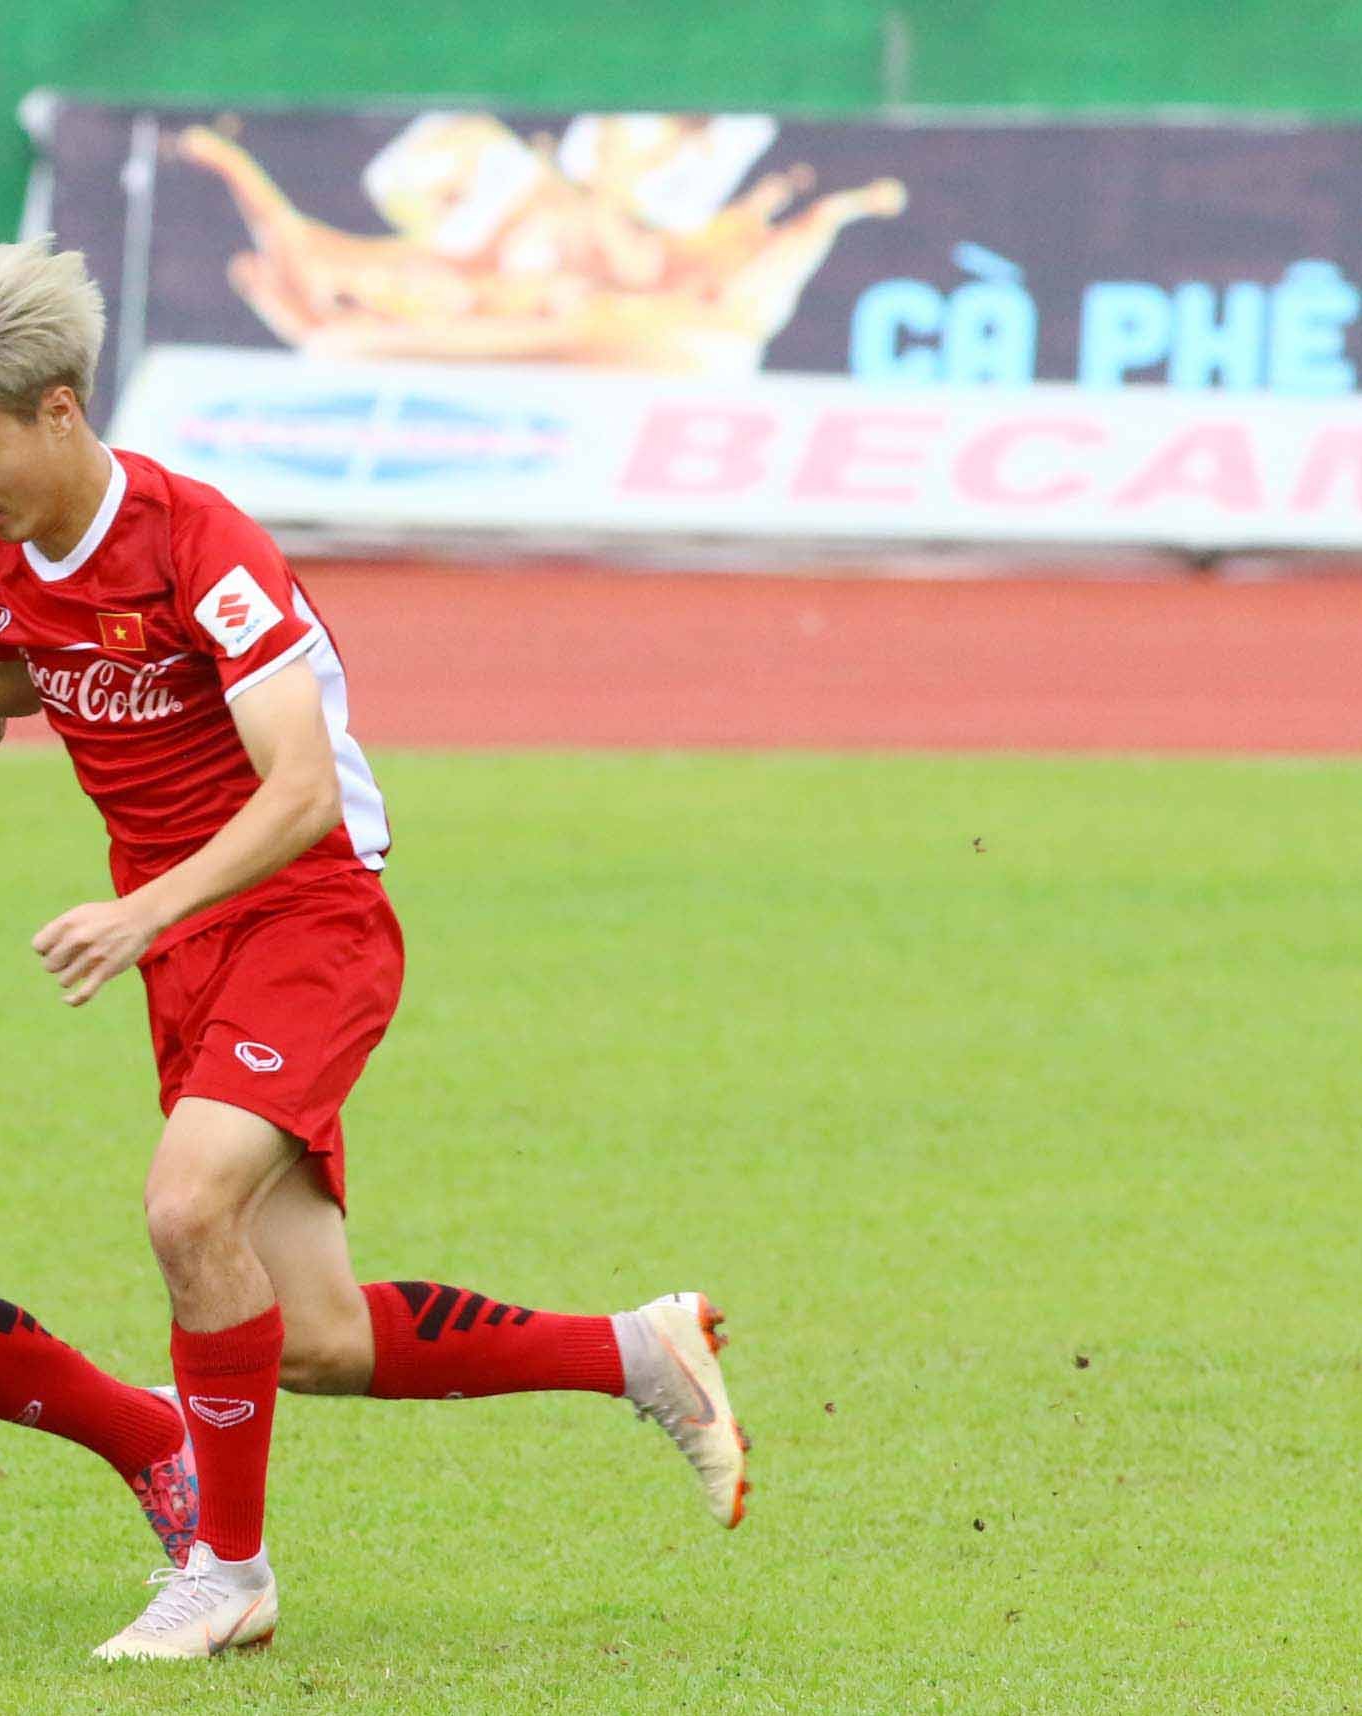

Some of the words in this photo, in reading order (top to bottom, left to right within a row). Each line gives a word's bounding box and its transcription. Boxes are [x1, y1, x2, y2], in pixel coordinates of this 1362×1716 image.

[850, 242, 1036, 388] CÀ
[1078, 259, 1360, 393] PHÊ
[19, 656, 174, 722] oca-Cola
